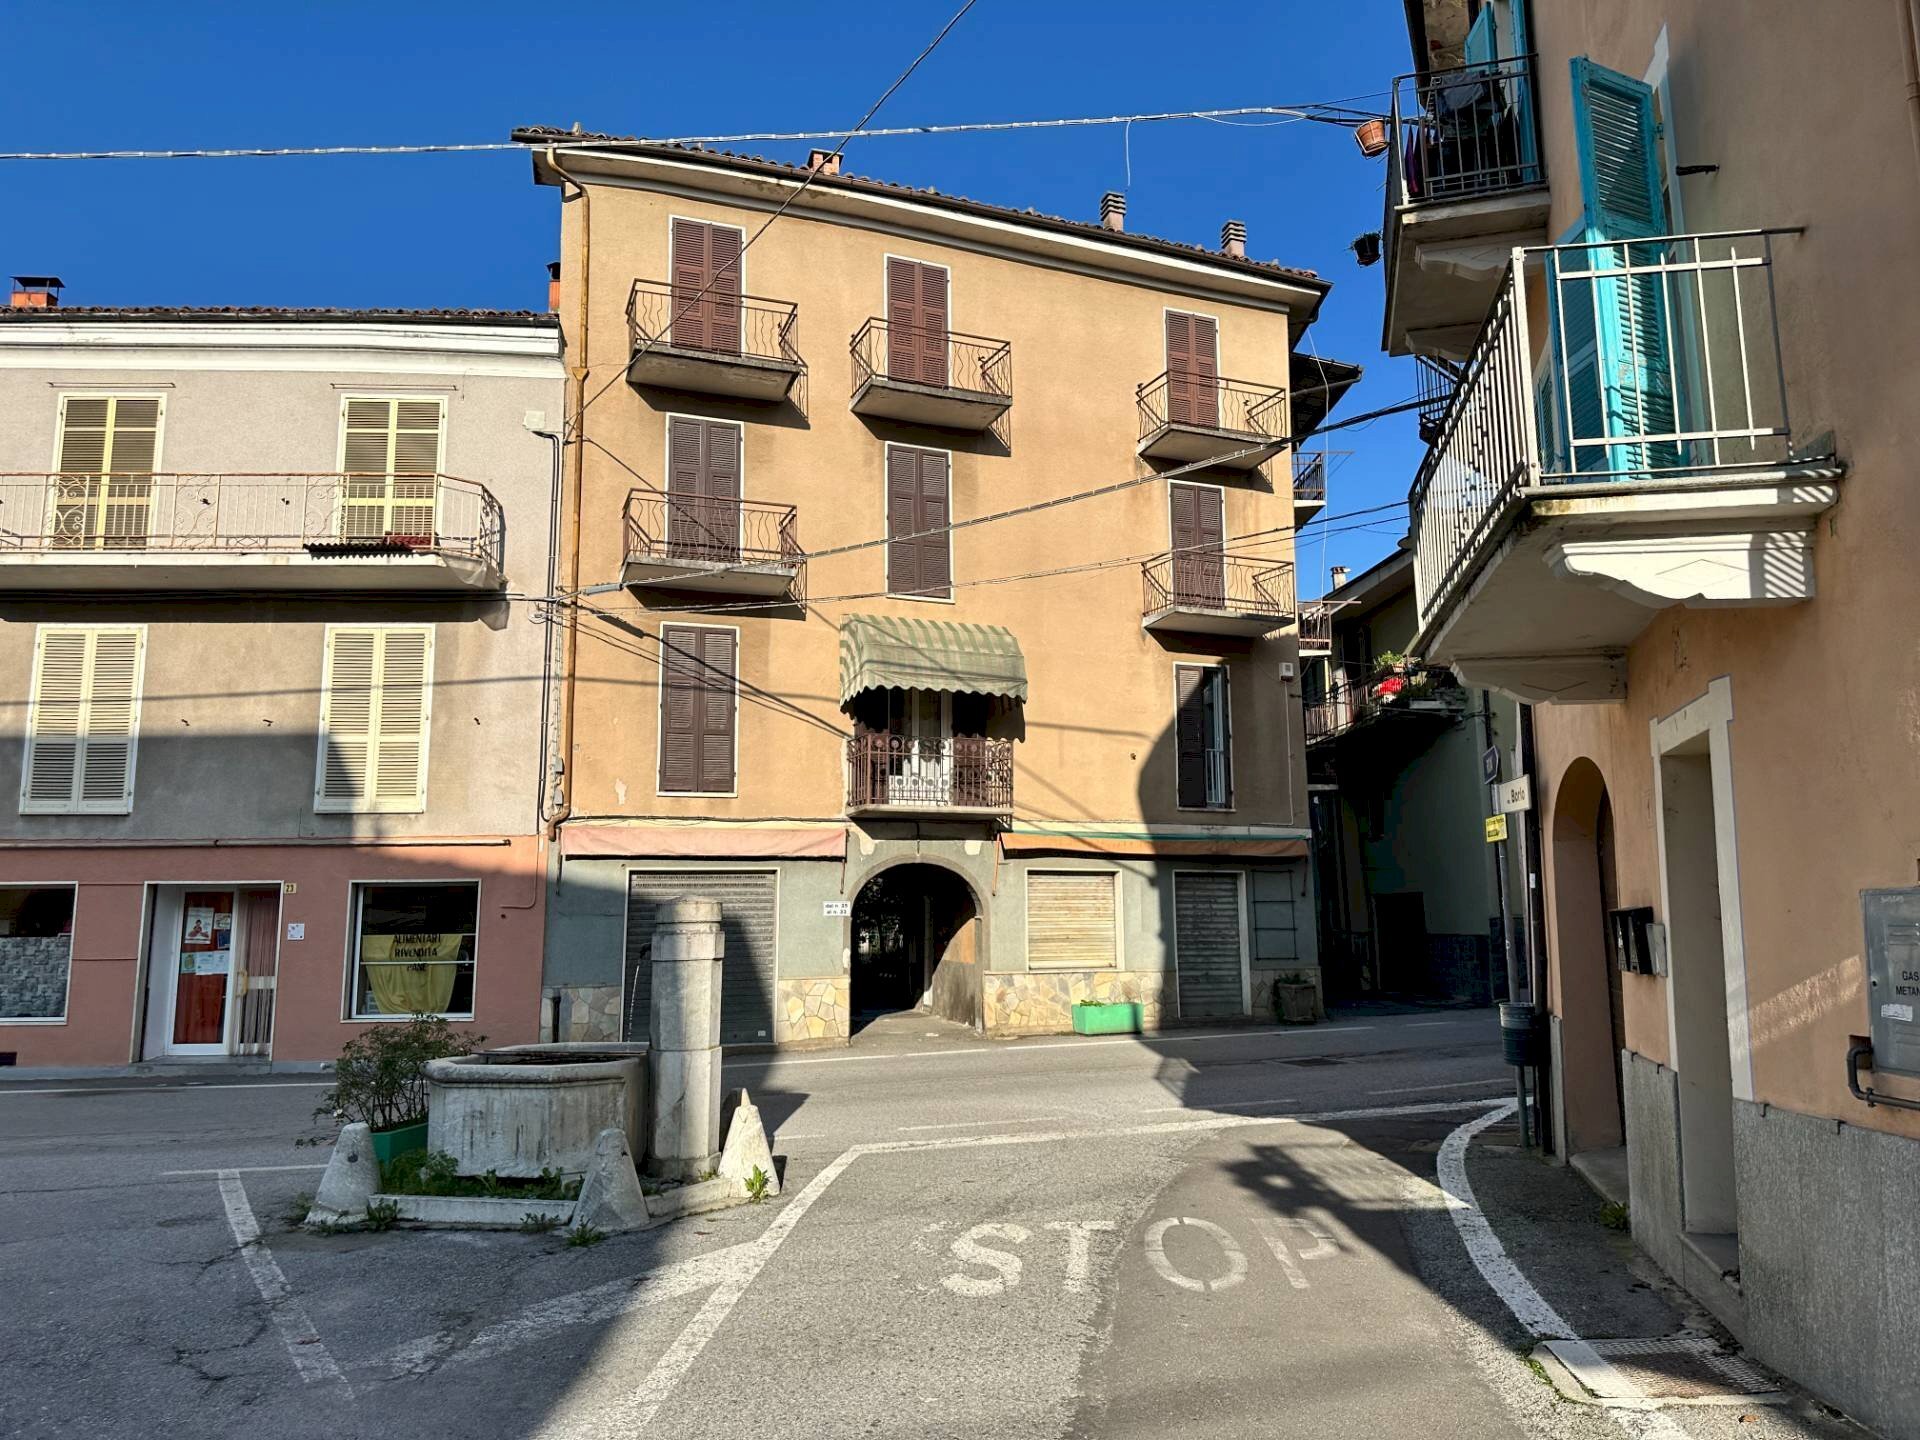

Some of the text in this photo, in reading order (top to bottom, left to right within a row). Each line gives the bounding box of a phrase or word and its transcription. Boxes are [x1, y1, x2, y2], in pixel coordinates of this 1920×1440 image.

[393, 933, 441, 944] ALIMENTARI
[394, 947, 437, 958] RIVENDITA
[1902, 971, 1920, 981] GAS
[938, 1215, 1343, 1298] STOP
